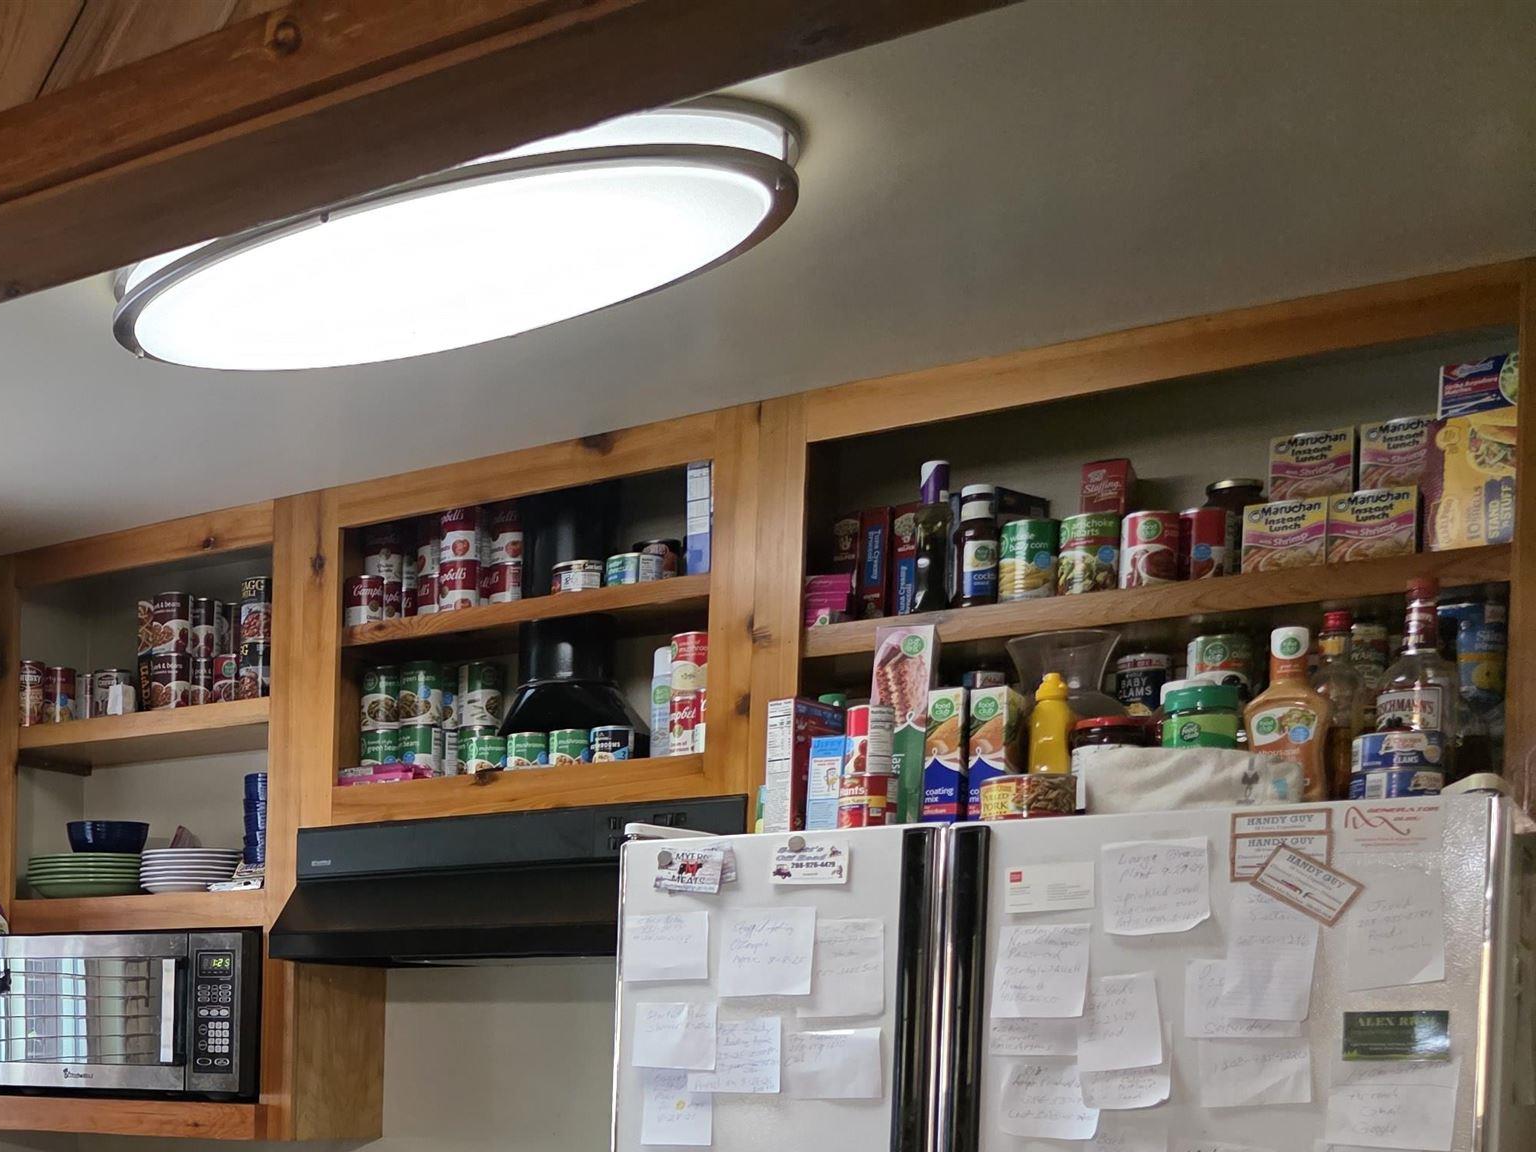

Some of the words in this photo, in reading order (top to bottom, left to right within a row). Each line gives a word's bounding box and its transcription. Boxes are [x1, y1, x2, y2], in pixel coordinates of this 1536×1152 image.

[1286, 431, 1347, 447] Maruchan
[1291, 445, 1332, 457] Instant
[1295, 453, 1327, 463] Lunch
[1299, 462, 1335, 477] Shrimp
[1348, 491, 1410, 507] Maruchan
[1261, 501, 1321, 518] Maruchan
[1351, 503, 1395, 515] Instant
[1265, 513, 1306, 526] Instant
[1355, 511, 1390, 522] Lunch
[1489, 500, 1500, 539] STAND
[1269, 522, 1302, 533] Lunch
[1360, 522, 1398, 537] Shrimp
[1273, 532, 1309, 547] Shrimp
[241, 578, 265, 592] AGG
[1120, 676, 1148, 689] BABY
[935, 701, 952, 709] food
[978, 700, 995, 708] food
[935, 708, 951, 716] club
[978, 707, 994, 715] club
[925, 787, 954, 797] coating
[924, 795, 939, 803] mix
[982, 801, 1009, 812] PORK
[1247, 815, 1288, 826] HANDY
[1290, 814, 1314, 823] GUY
[1247, 838, 1288, 848] HANDY
[1290, 836, 1315, 846] GUY
[1285, 854, 1323, 877] HANDY
[1321, 873, 1346, 890] GUY
[670, 875, 705, 885] MEATS
[1357, 1016, 1395, 1027] ALEX
